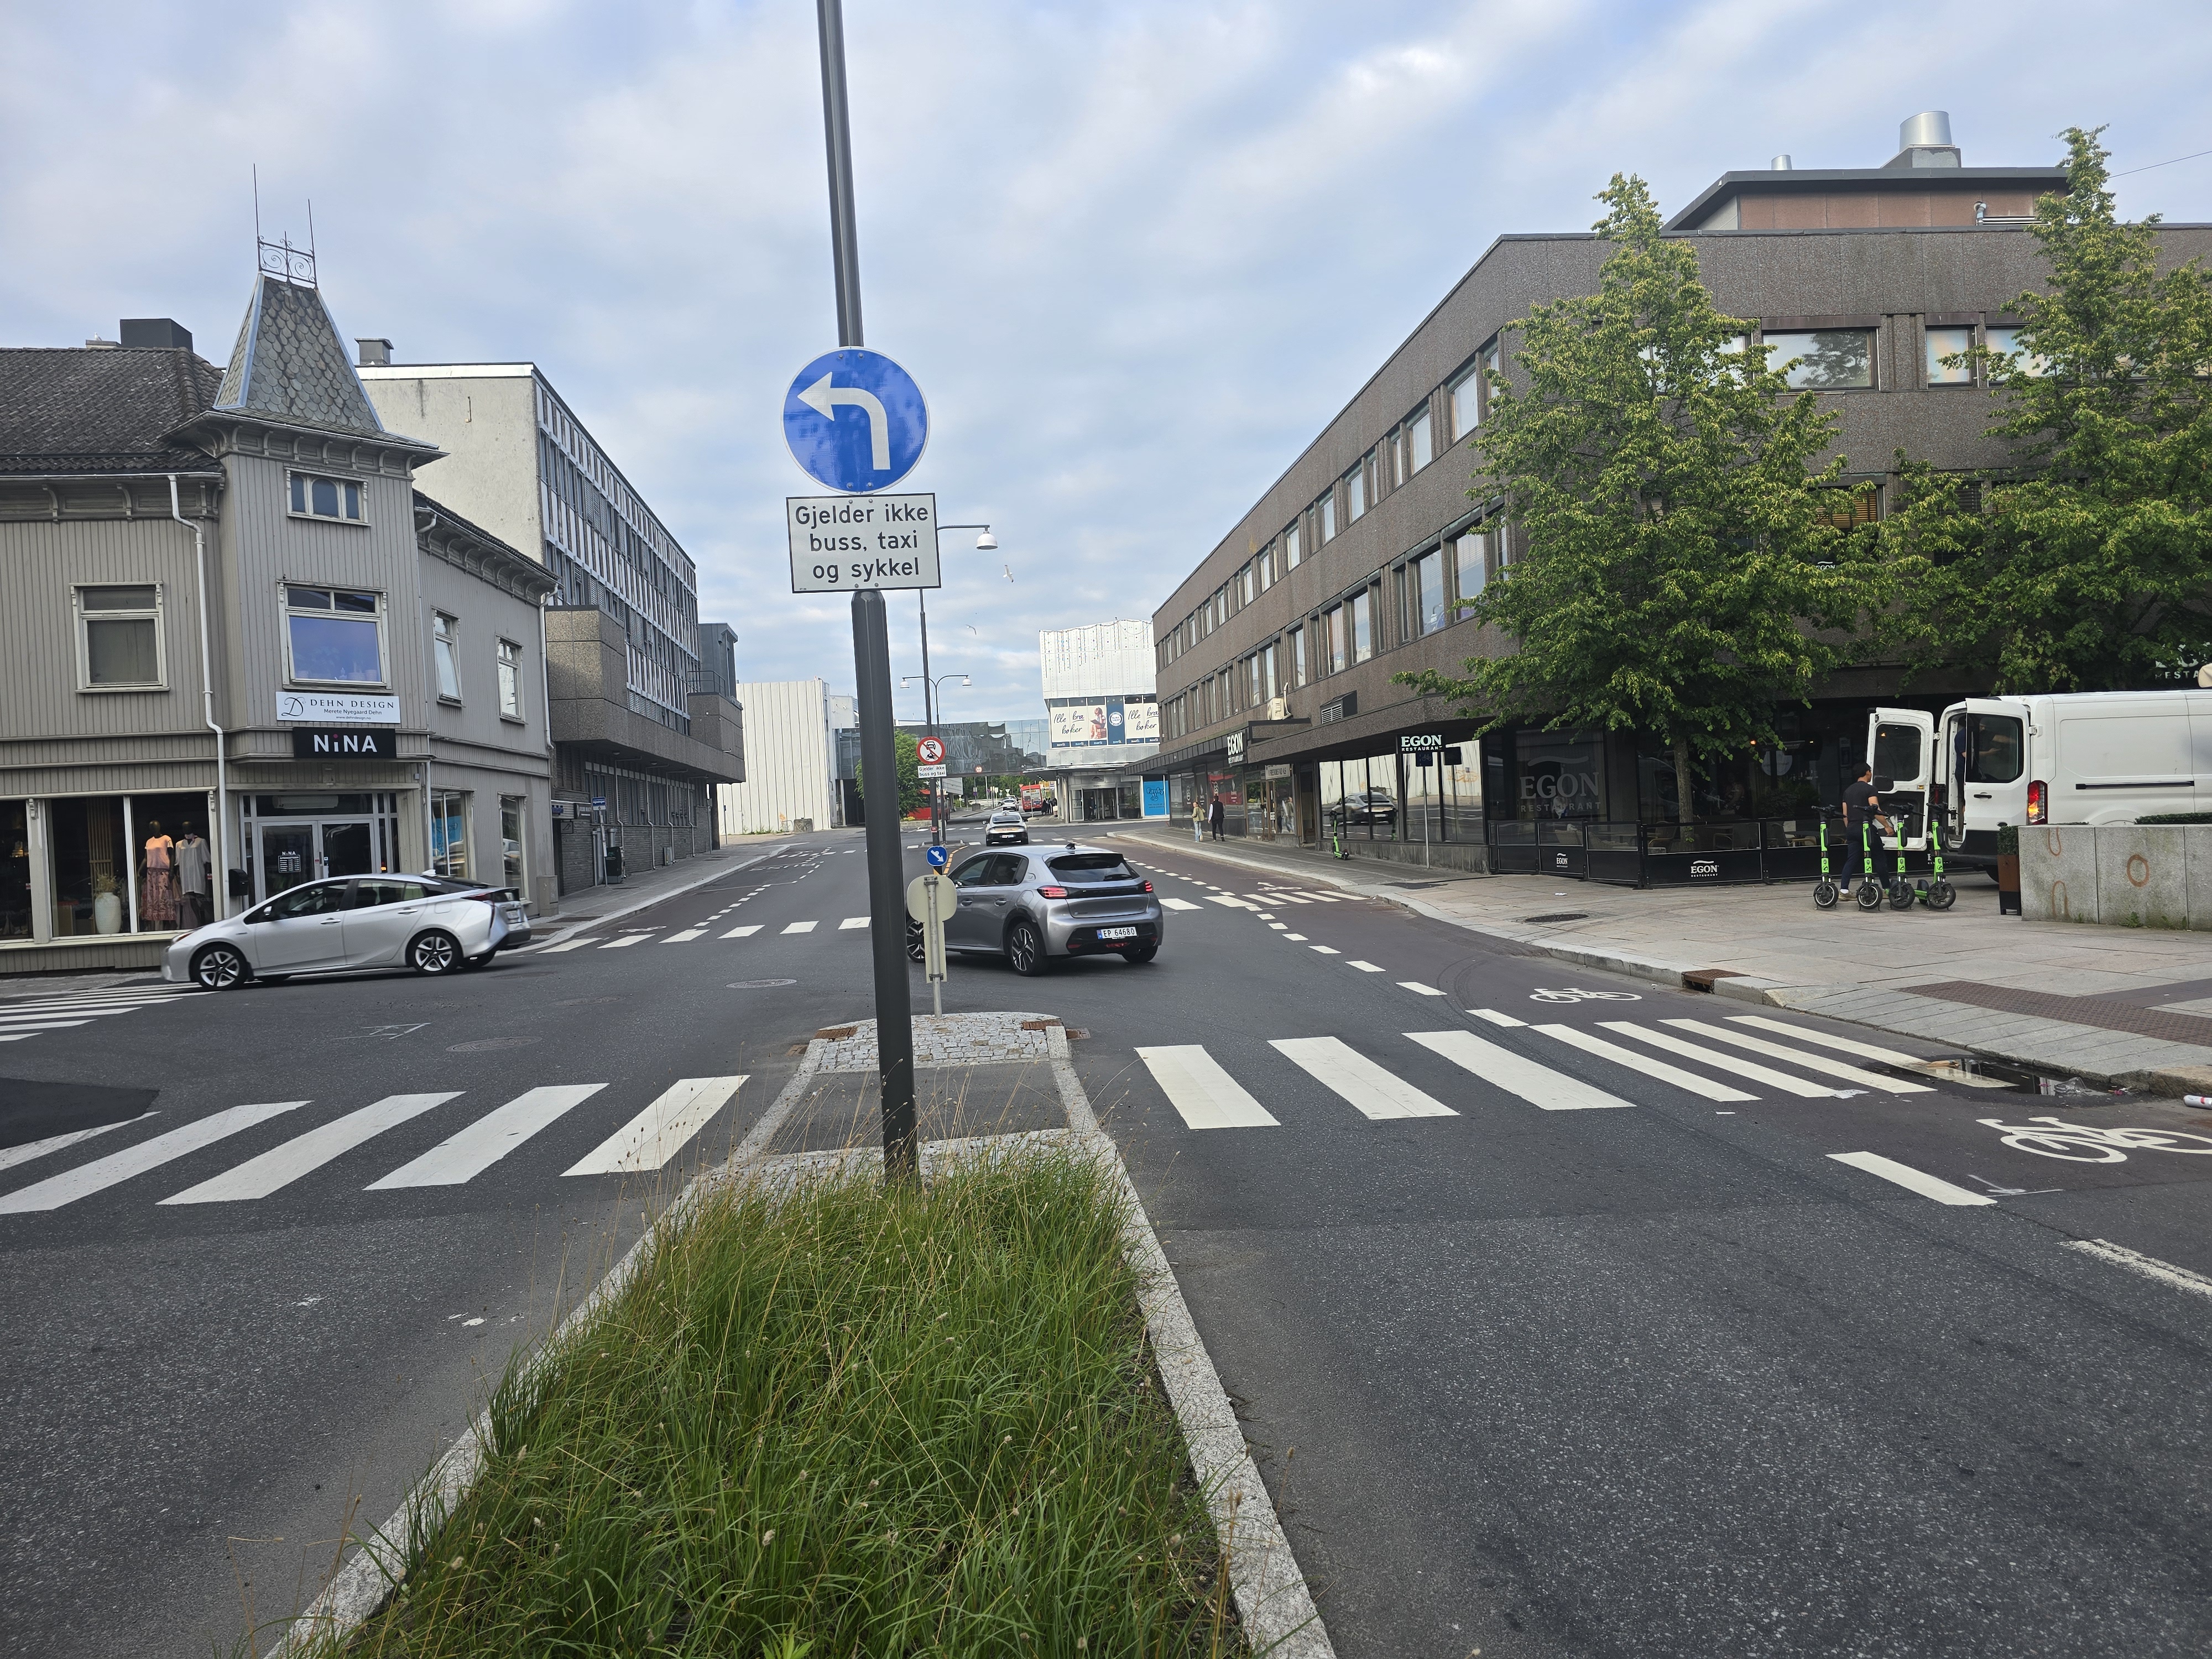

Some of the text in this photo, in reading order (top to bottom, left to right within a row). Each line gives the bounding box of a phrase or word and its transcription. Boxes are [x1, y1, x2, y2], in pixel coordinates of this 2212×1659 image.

[795, 503, 928, 529] Gjelder ikke
[810, 530, 917, 551] buss, taxi
[813, 557, 919, 583] og sykkel
[1072, 711, 1084, 720] bra
[1147, 707, 1159, 716] bra
[1227, 732, 1243, 755] EGON
[1401, 735, 1442, 747] EGON
[1520, 771, 1599, 799] EGON
[1521, 802, 1601, 812] RESTAURANT
[1691, 865, 1717, 873] EGON
[1115, 928, 1135, 936] 64680
